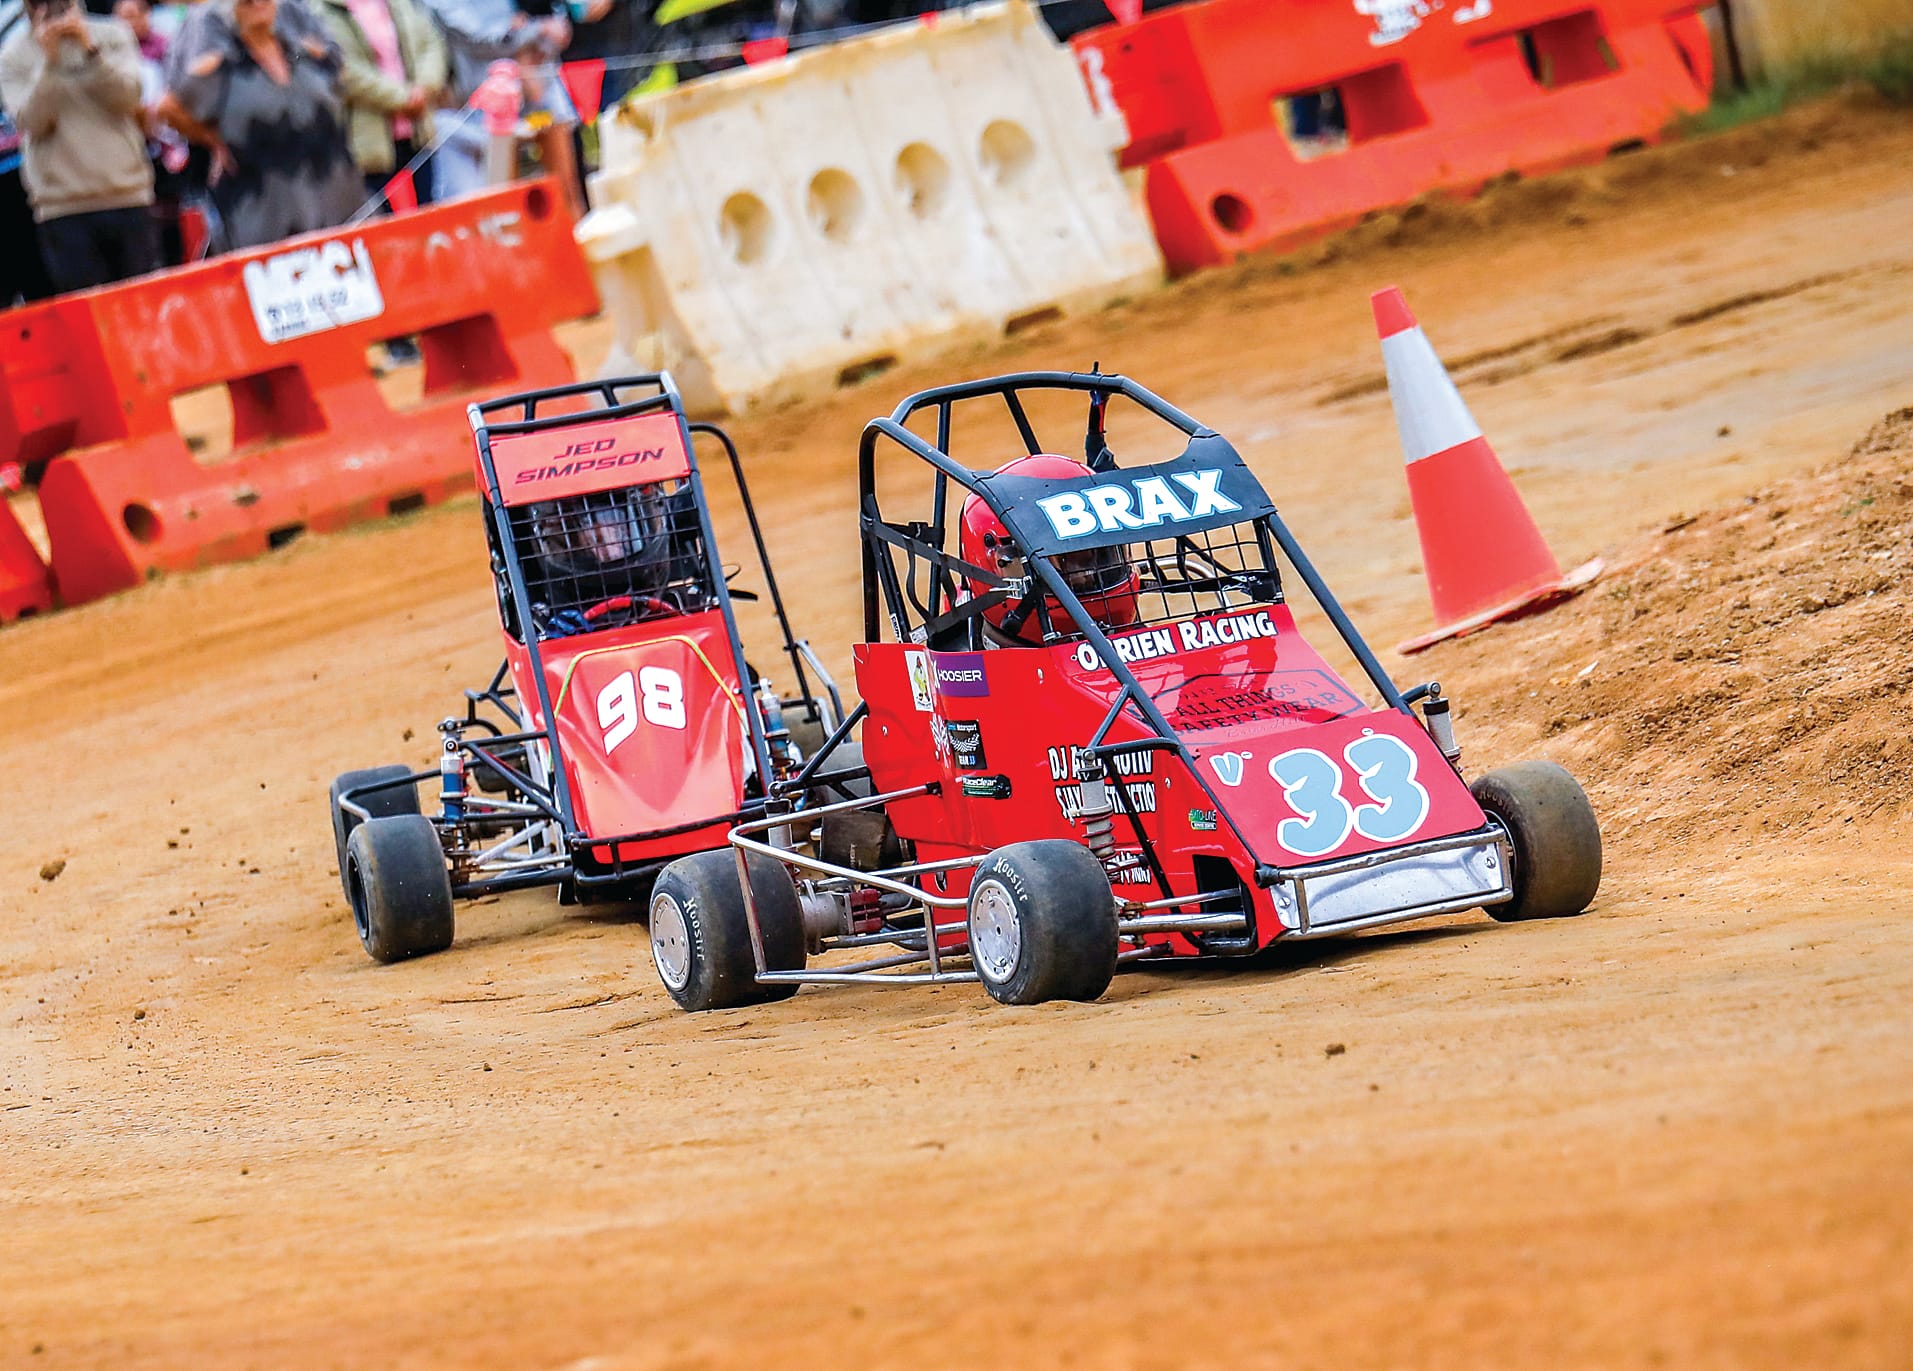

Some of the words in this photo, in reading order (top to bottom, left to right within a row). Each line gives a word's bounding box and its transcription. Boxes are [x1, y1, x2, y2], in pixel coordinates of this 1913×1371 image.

[514, 448, 664, 485] SIMPSON
[554, 438, 616, 461] JED
[1036, 469, 1242, 540] BRAX
[1077, 630, 1176, 671] ORIEN
[1178, 612, 1278, 651] RACING
[938, 669, 983, 682] HOOSIER
[596, 666, 687, 757] 98
[1172, 713, 1259, 737] SAFETY
[1264, 693, 1345, 717] WEAR
[1177, 700, 1222, 717] ALL
[1216, 684, 1296, 712] THINGS
[1048, 747, 1069, 780] DJ
[1209, 752, 1244, 787] V
[1268, 734, 1430, 857] 33
[993, 857, 1028, 902] Hoosier
[684, 897, 705, 961] Hoosier
